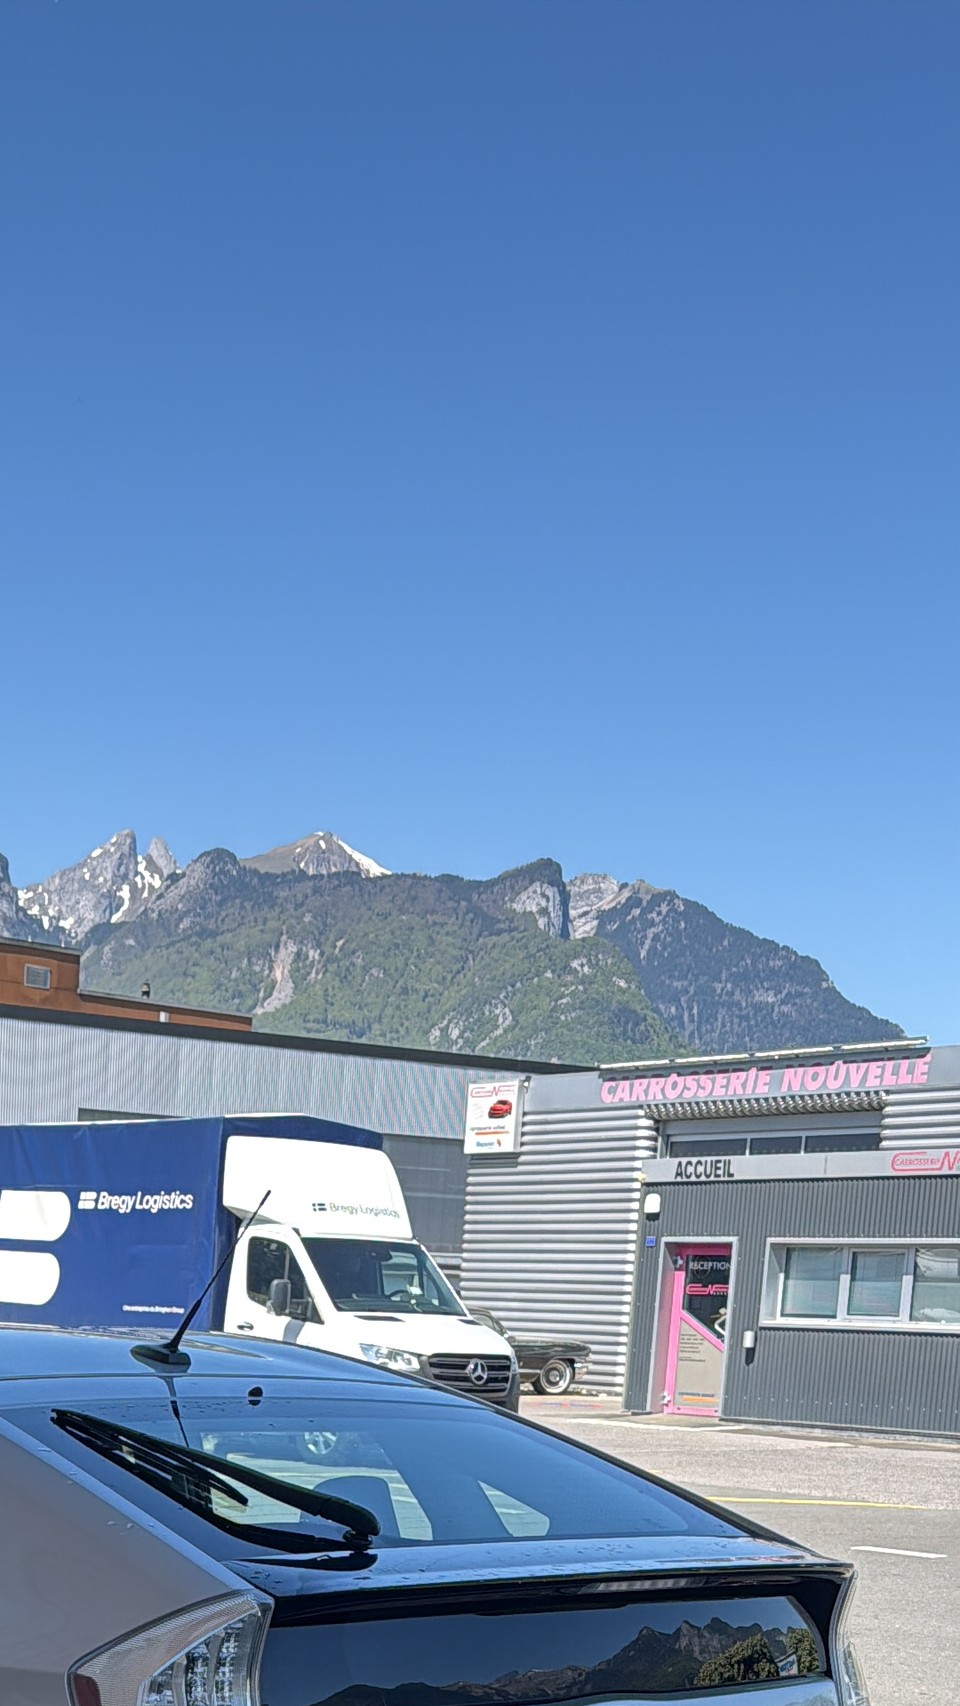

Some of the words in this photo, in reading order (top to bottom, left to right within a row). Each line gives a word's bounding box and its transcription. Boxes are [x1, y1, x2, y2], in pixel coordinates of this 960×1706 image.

[600, 1066, 772, 1104] CARROSSERIE
[781, 1053, 933, 1093] NOUVELLE
[674, 1159, 735, 1180] ACCUEIL
[97, 1191, 136, 1214] Bregy
[135, 1190, 194, 1214] Logistics
